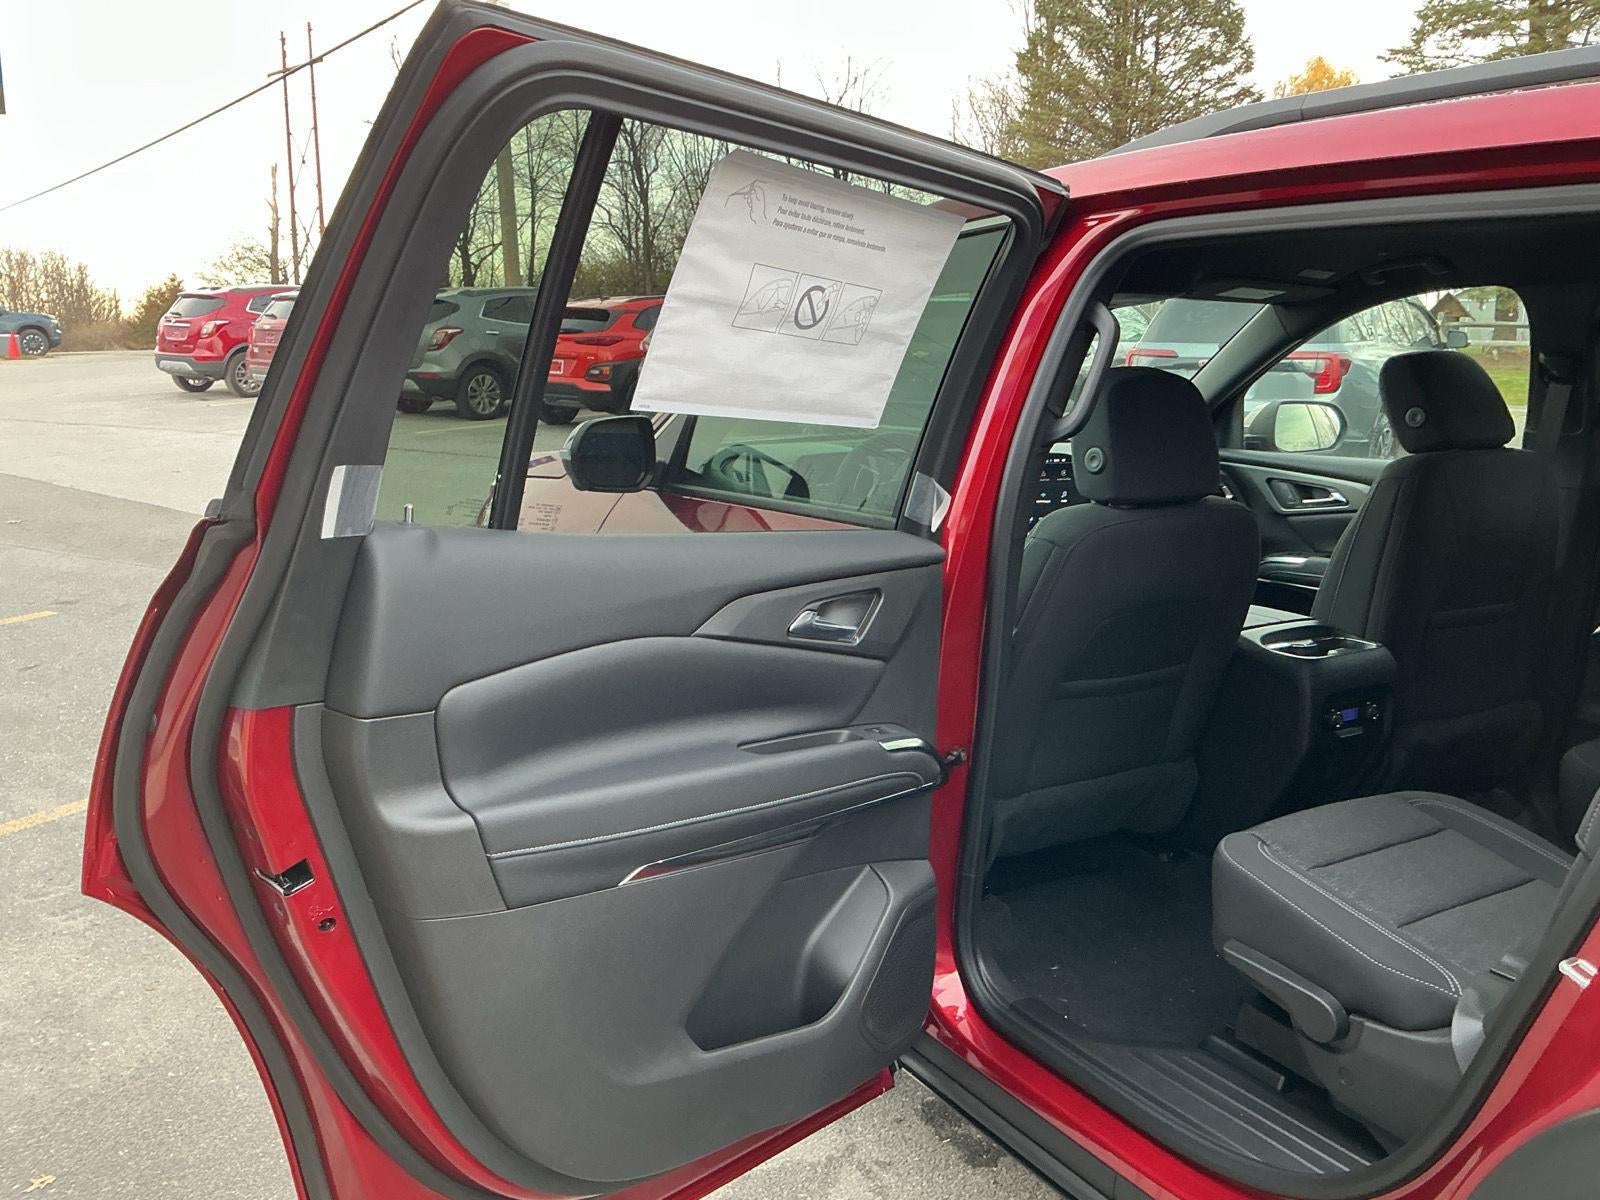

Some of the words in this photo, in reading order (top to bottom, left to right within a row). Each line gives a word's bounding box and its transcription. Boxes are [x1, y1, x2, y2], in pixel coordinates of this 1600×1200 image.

[782, 193, 788, 202] To
[788, 195, 798, 205] help
[777, 206, 788, 215] Pour
[773, 217, 784, 228] Para
